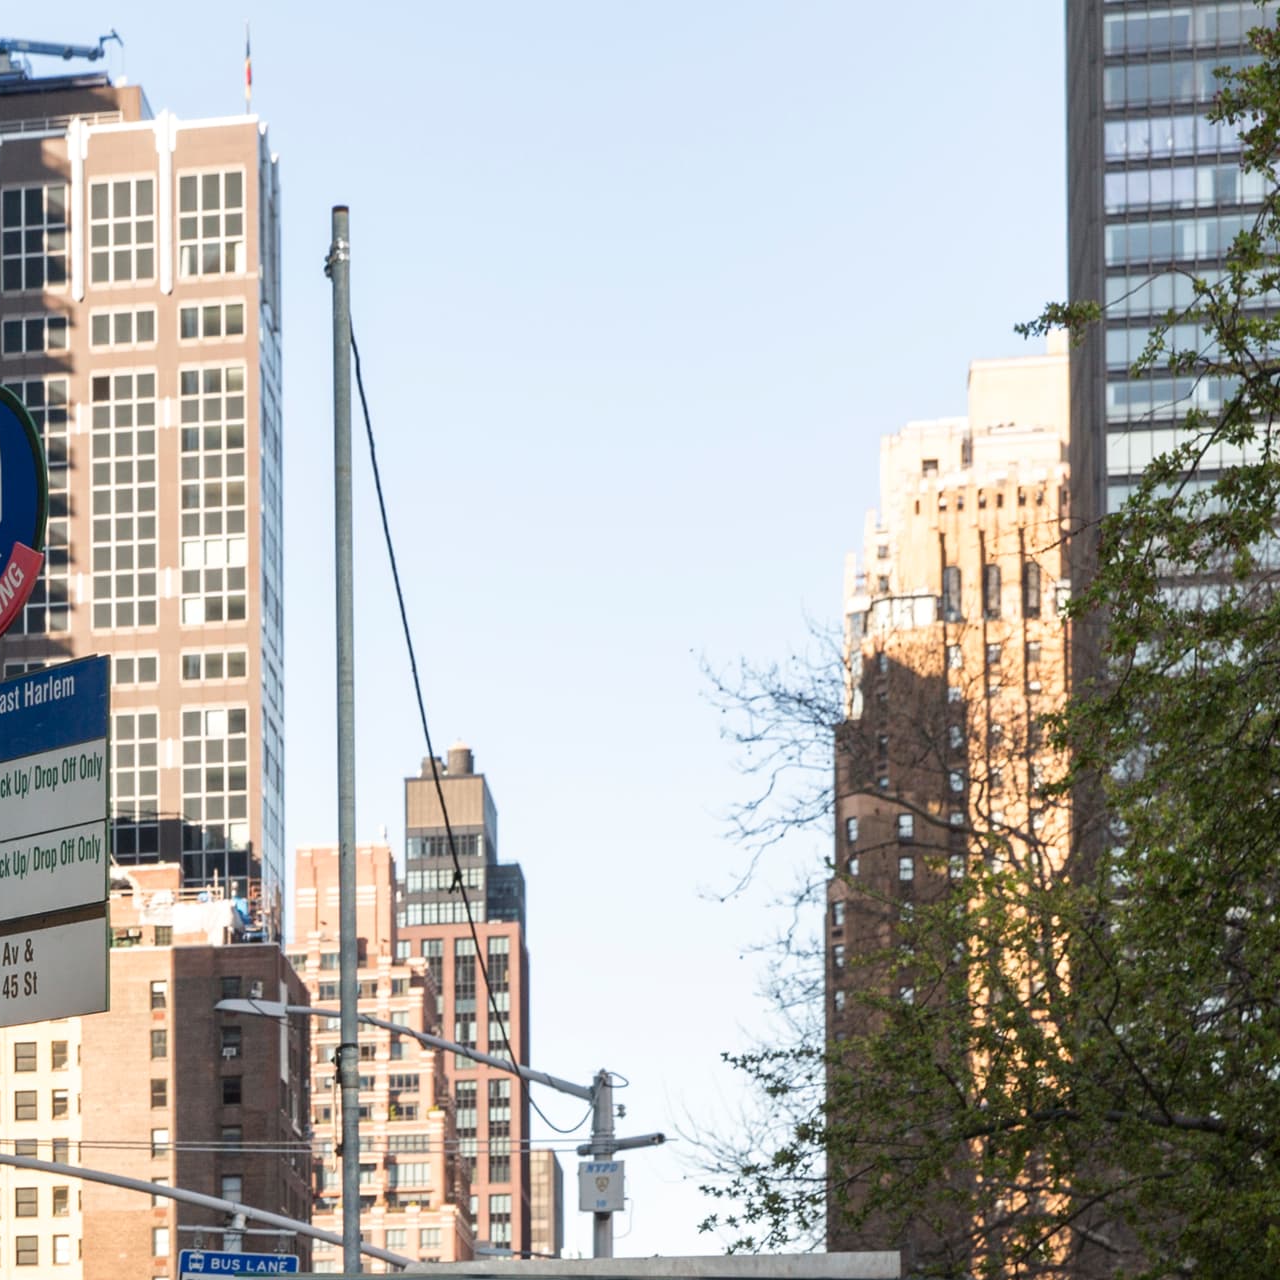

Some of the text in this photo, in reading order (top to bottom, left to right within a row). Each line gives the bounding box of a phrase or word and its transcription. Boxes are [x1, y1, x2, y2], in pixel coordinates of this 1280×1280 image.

[24, 675, 75, 707] Harlem
[14, 767, 32, 799] Up/
[35, 765, 58, 792] Drop
[62, 756, 76, 784] Off
[80, 752, 103, 782] Only
[13, 848, 30, 880] Up/
[33, 846, 57, 873] Drop
[60, 839, 75, 865] Off
[78, 834, 101, 864] Only
[2, 942, 19, 967] Av
[24, 938, 34, 964] &
[3, 974, 19, 999] 45
[24, 971, 38, 996] St
[210, 1258, 288, 1272] BUS LANE
